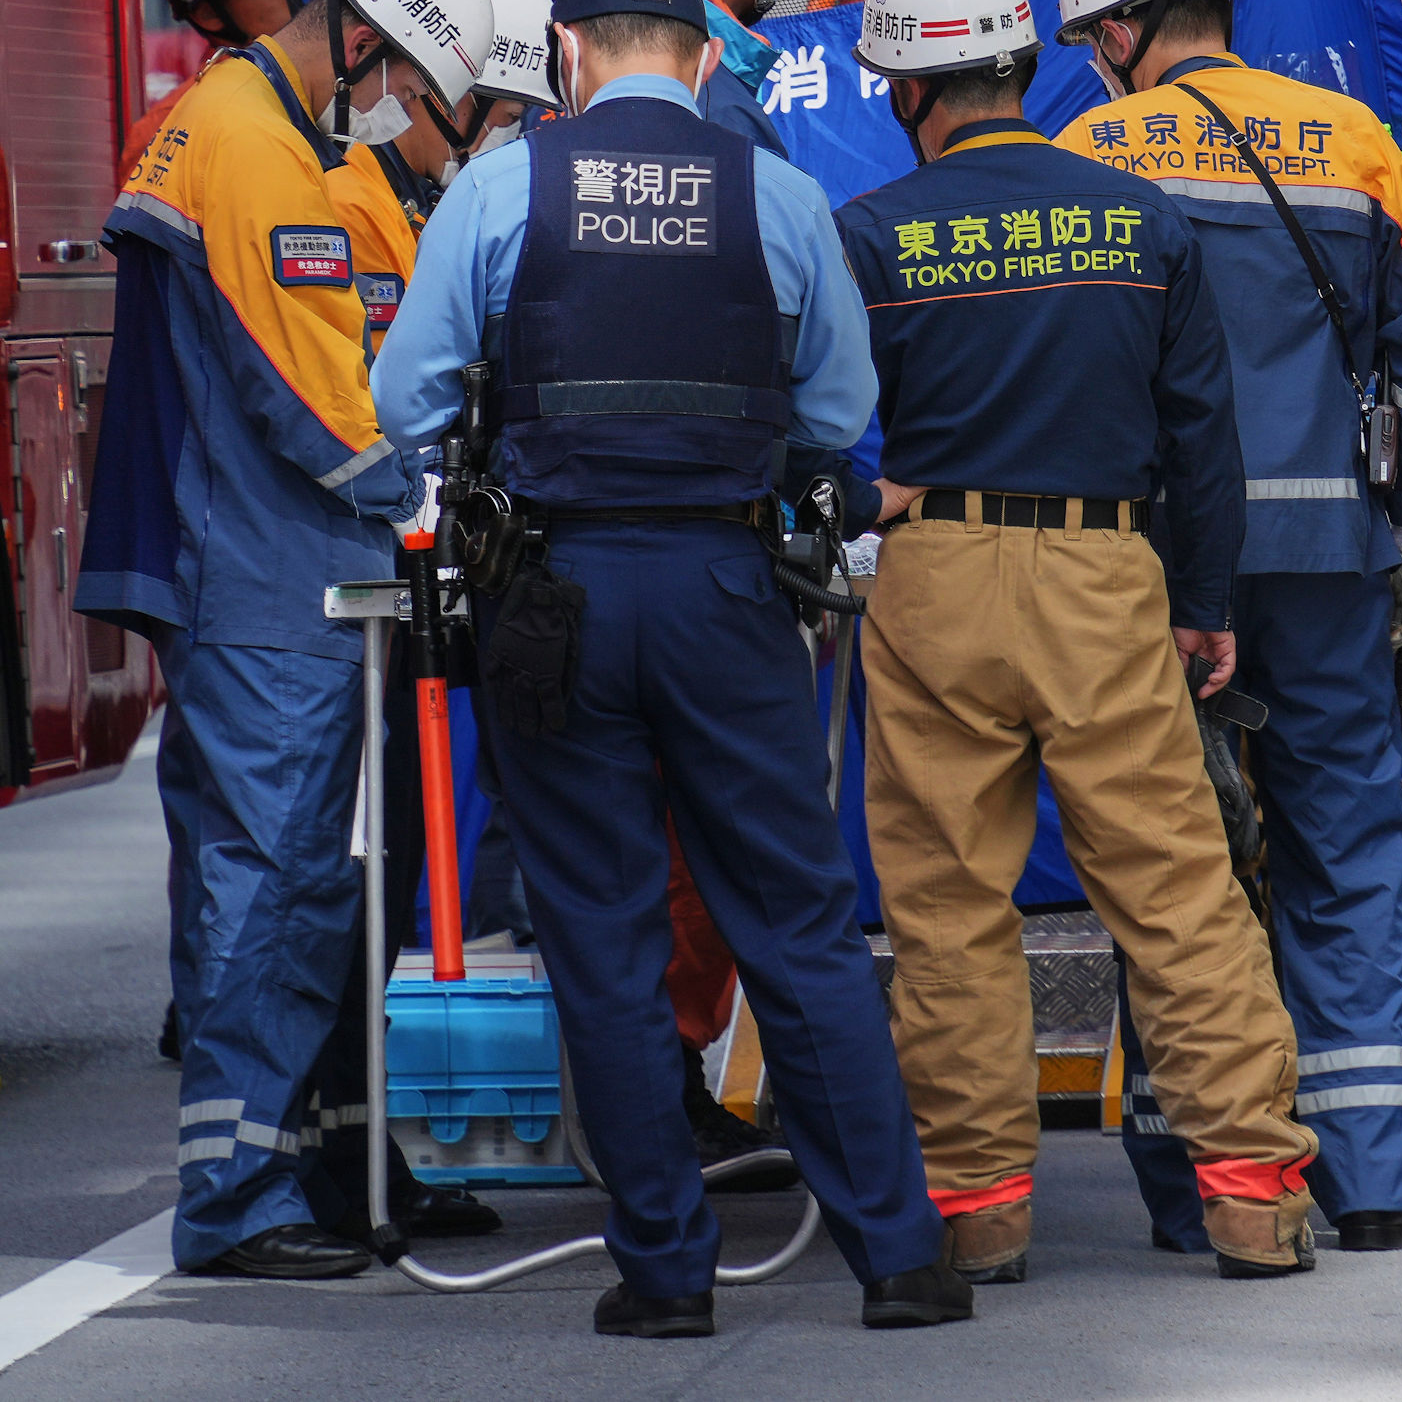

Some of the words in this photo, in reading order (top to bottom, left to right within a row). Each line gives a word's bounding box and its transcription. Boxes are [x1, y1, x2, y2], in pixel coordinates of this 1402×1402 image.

[979, 12, 1013, 34] 警防
[1088, 112, 1333, 154] 東京消防庁
[1097, 150, 1185, 173] TOKYO
[1195, 152, 1253, 174] FIRE
[1265, 155, 1336, 177] DEPT.
[573, 158, 712, 207] 警視庁
[577, 212, 708, 246] POLICE
[894, 205, 1142, 261] 東京消防庁
[284, 241, 330, 252] 救急機動部隊
[297, 260, 337, 270] 救急救命士
[899, 259, 997, 289] TOKYO
[1003, 252, 1063, 279] FIRE
[1070, 249, 1142, 275] DEPT.
